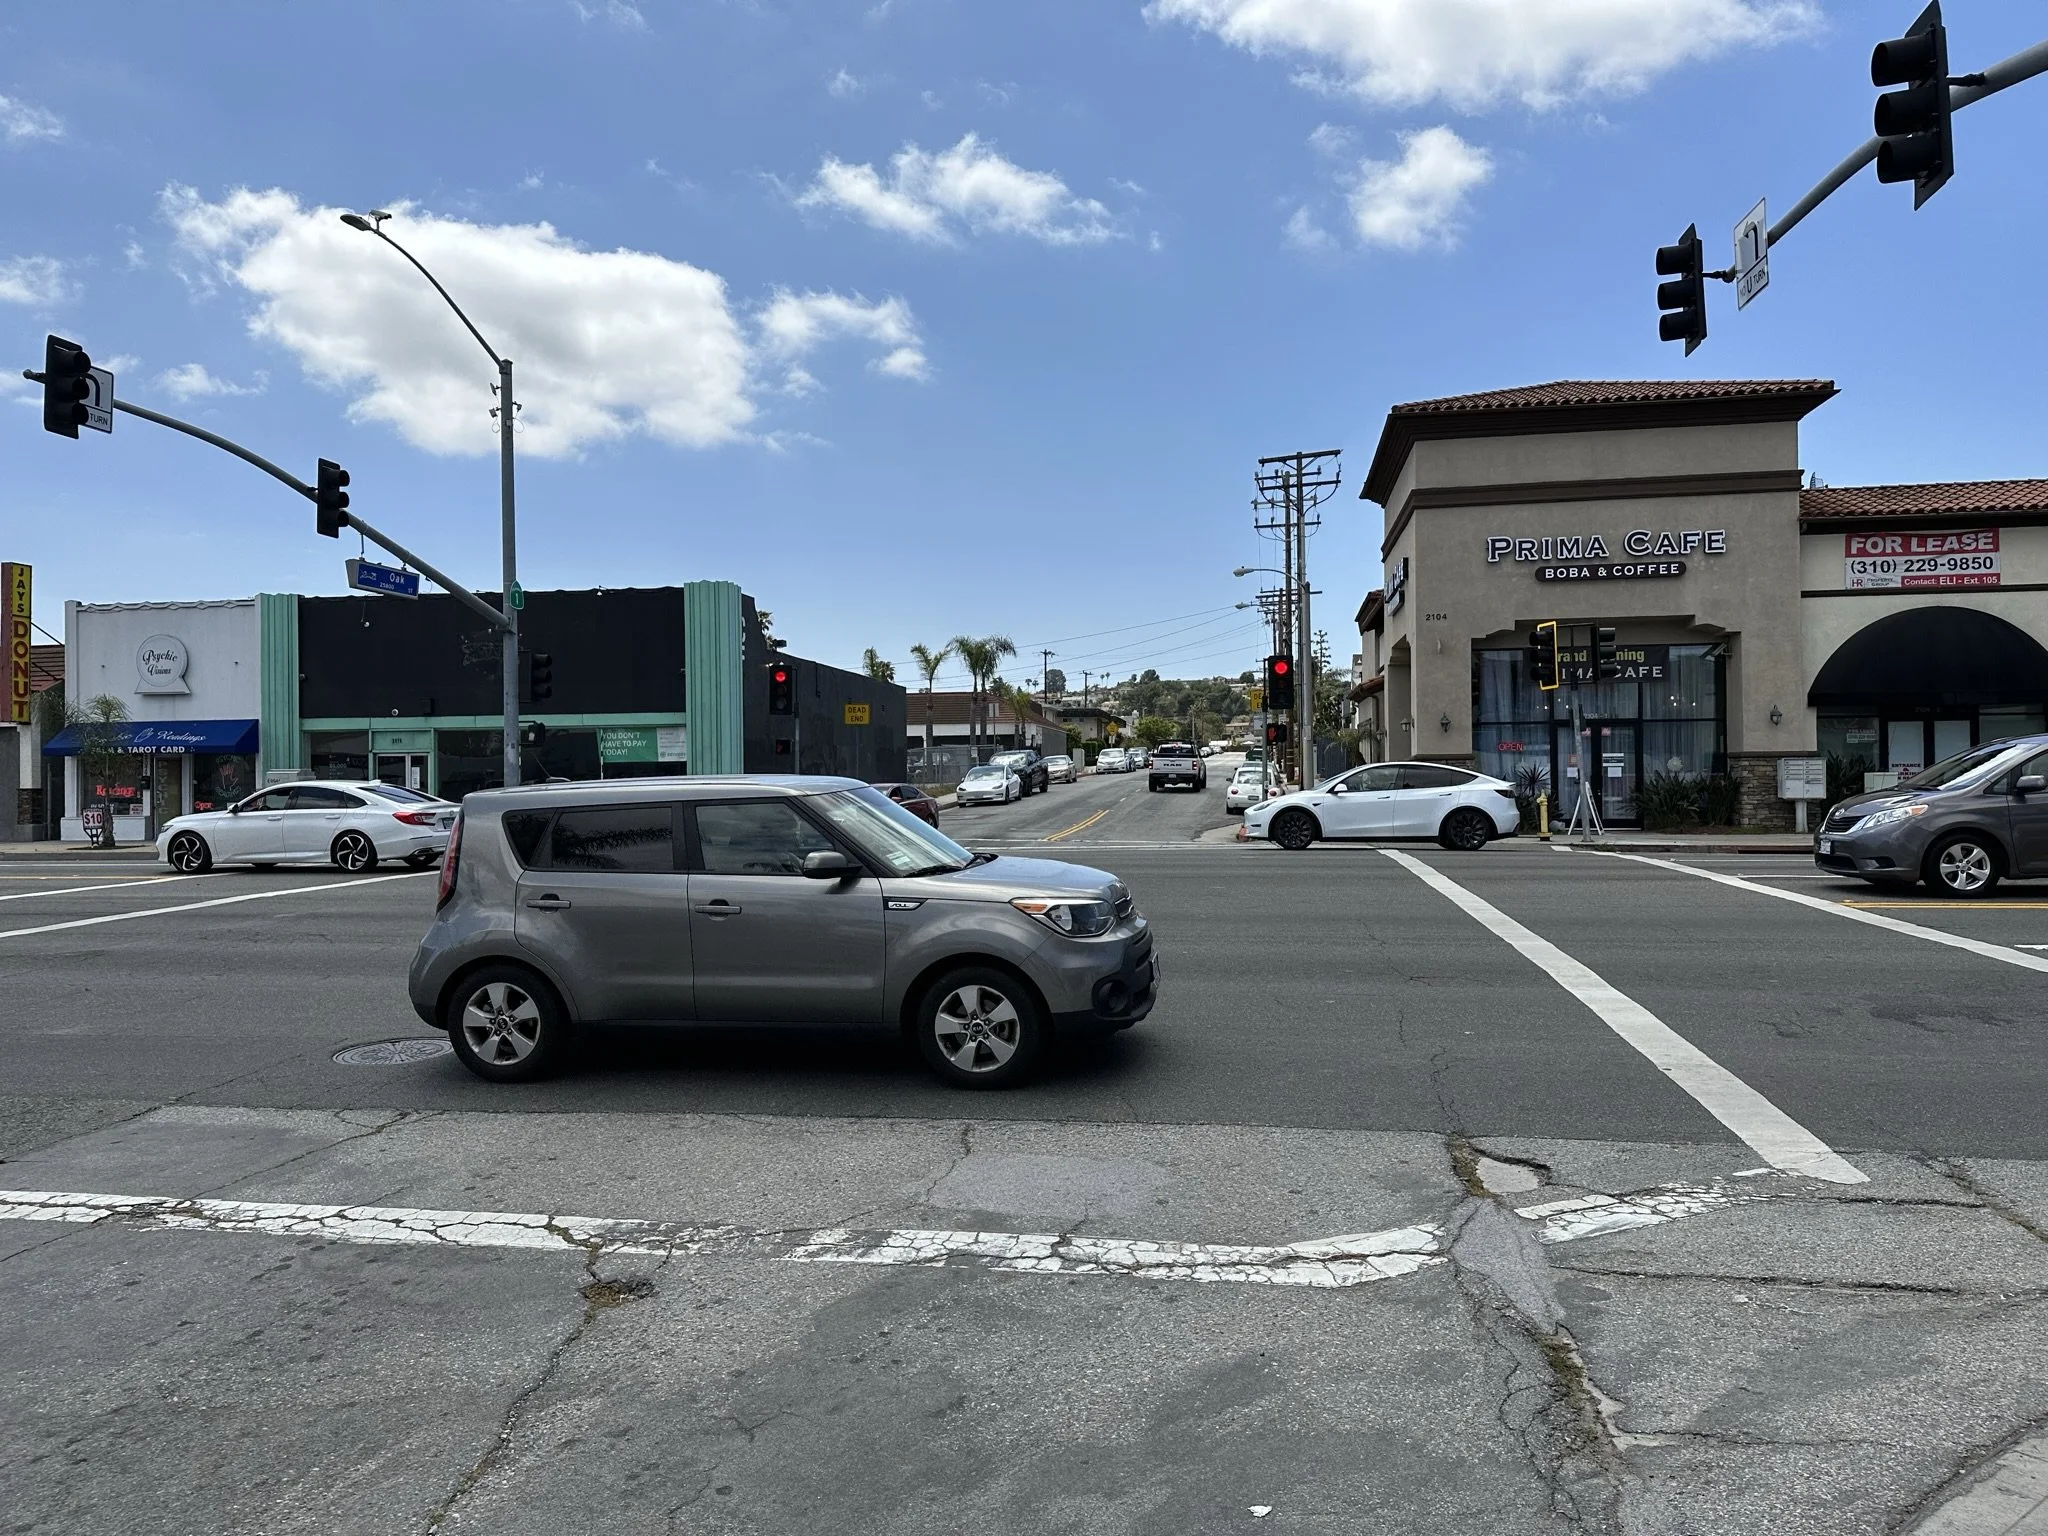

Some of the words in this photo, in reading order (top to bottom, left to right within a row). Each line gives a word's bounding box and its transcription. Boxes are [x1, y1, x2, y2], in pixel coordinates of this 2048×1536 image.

[1746, 276, 1753, 293] U
[90, 413, 108, 426] TURN
[1487, 535, 1609, 562] PRIMA
[1624, 529, 1726, 555] CAFE
[1850, 536, 1902, 555] FOR
[1911, 532, 1993, 552] LEASE
[1545, 567, 1590, 579] BOBA
[1598, 567, 1607, 577] &
[1613, 563, 1679, 576] COFFEE
[1851, 559, 1897, 574] (310)
[1904, 556, 1994, 573] 229-9850
[389, 572, 405, 585] Oak
[1851, 579, 1863, 587] HR
[1940, 577, 1956, 585] ELI
[1983, 576, 1997, 584] 105
[16, 567, 26, 613] JAYS
[379, 582, 395, 590] 25800
[1425, 613, 1447, 621] 2104
[142, 649, 178, 665] Psychic
[1558, 650, 1587, 662] rand
[13, 620, 29, 718] DONUT
[147, 664, 171, 676] Visions
[602, 732, 617, 740] YOU
[618, 731, 641, 739] DON'T
[127, 746, 157, 754] TAROT
[160, 746, 185, 754] CARD
[603, 740, 622, 748] HAVE
[1498, 743, 1524, 751] OPEN
[603, 748, 628, 756] TODAY!
[195, 801, 213, 810] Open
[84, 813, 102, 825] $10
